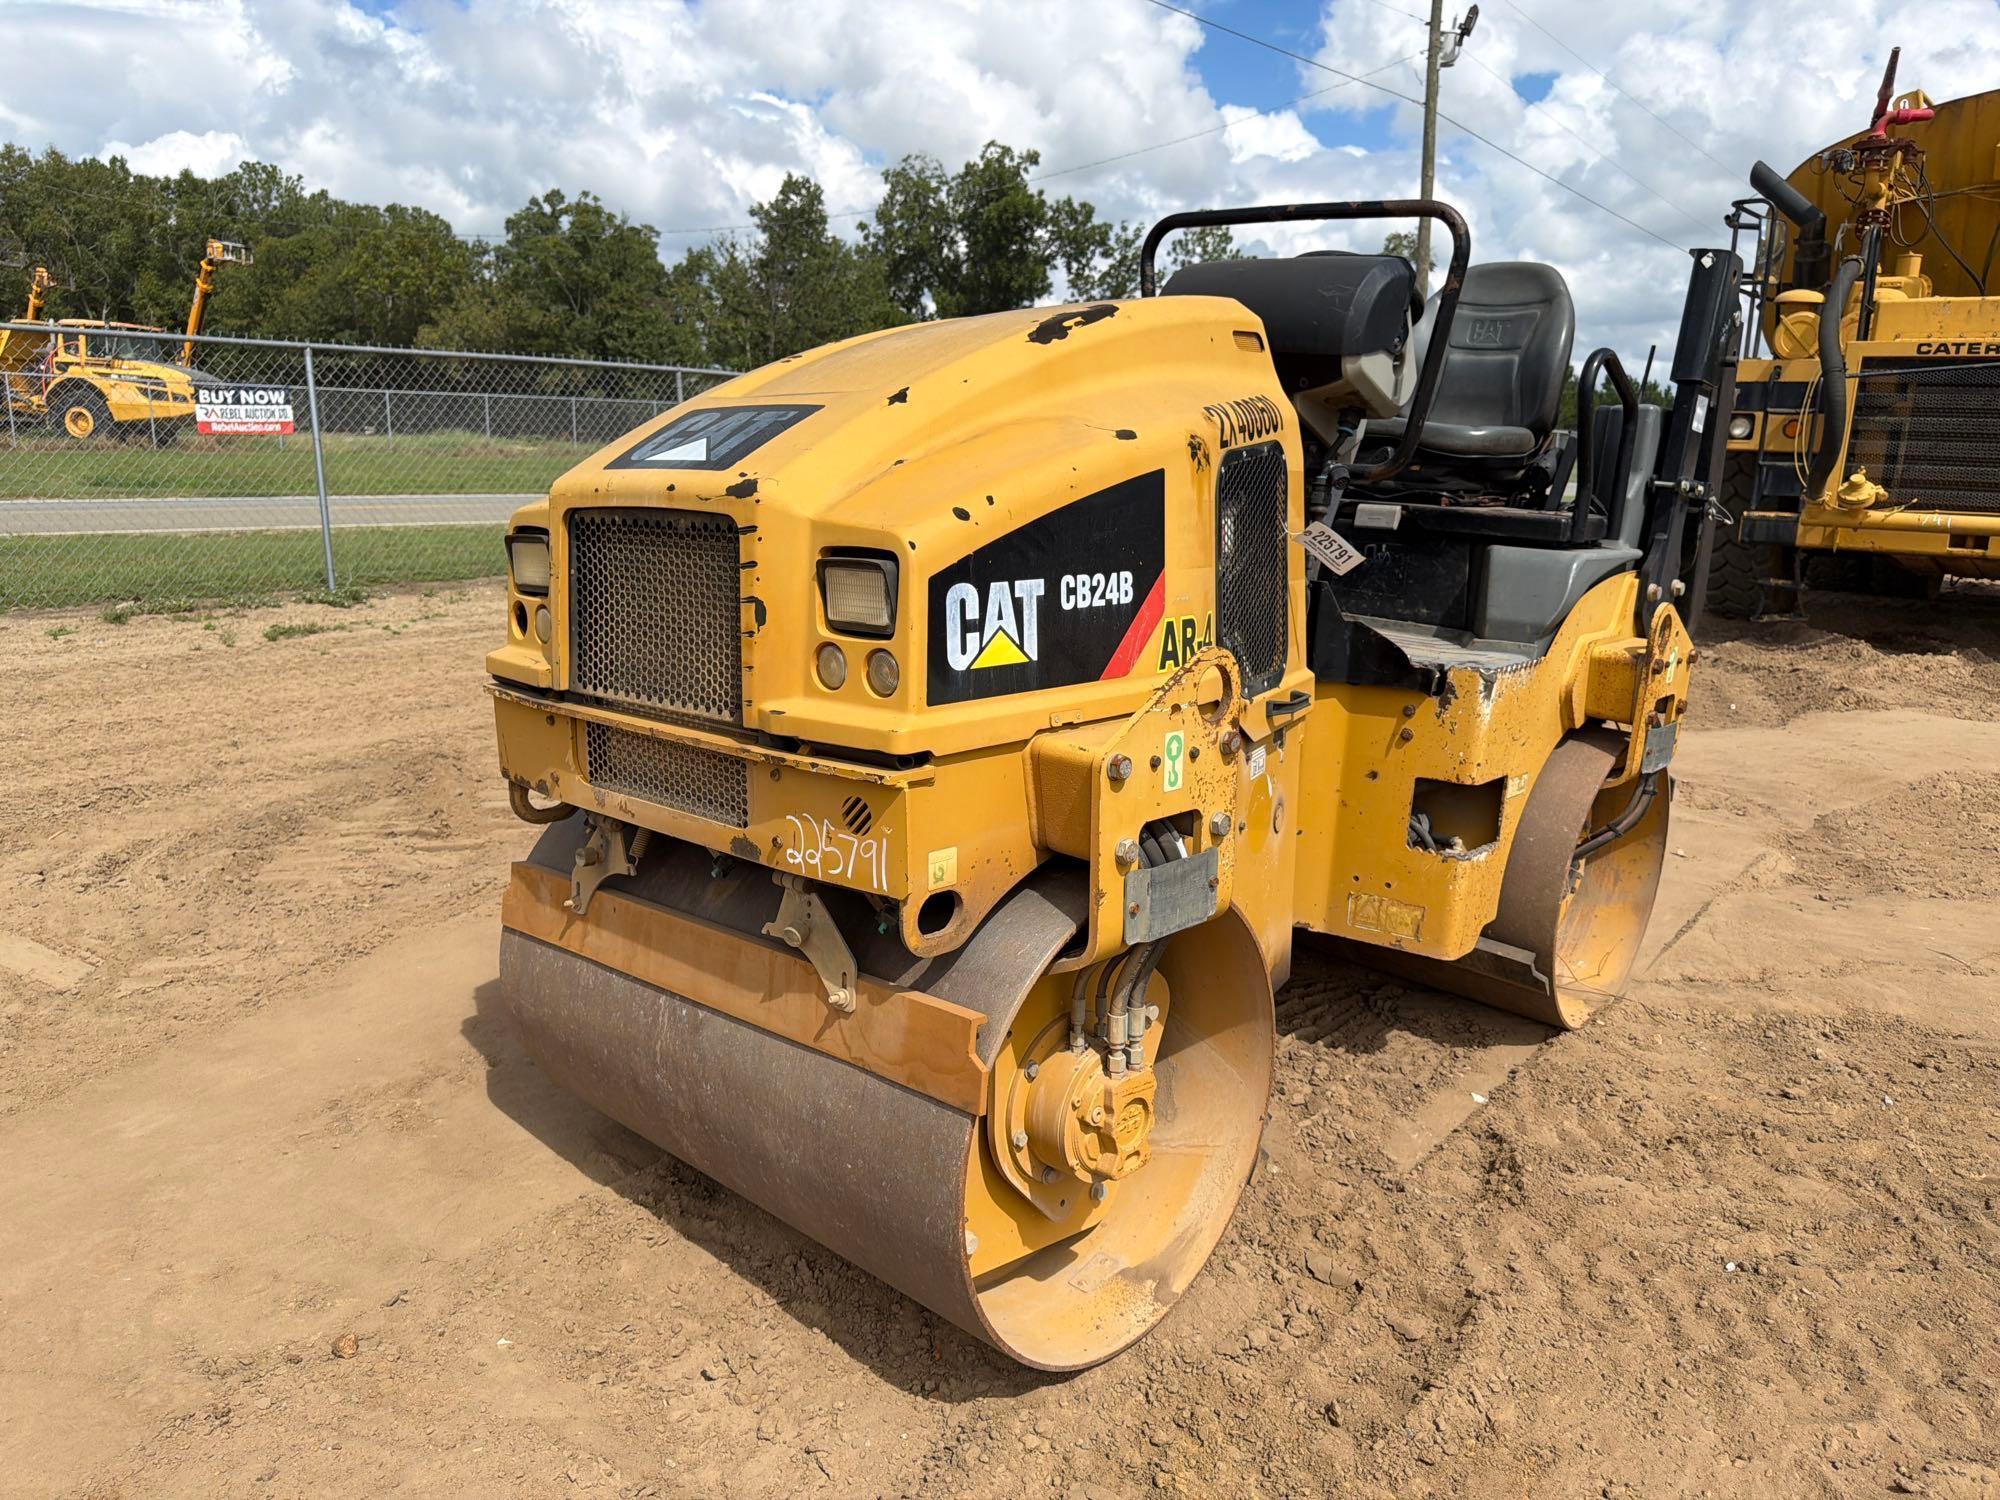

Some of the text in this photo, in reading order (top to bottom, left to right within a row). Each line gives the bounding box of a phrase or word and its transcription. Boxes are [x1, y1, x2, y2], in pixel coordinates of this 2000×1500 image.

[1467, 319, 1512, 344] CAT
[1916, 342, 2000, 355] CATER
[199, 389, 285, 404] BUY NOW
[220, 408, 241, 419] REBEL
[245, 408, 276, 419] AUCTION
[630, 411, 800, 461] CAT
[1312, 530, 1354, 565] 225791
[945, 571, 1134, 671] CAT CB24B
[785, 812, 888, 893] 225791
